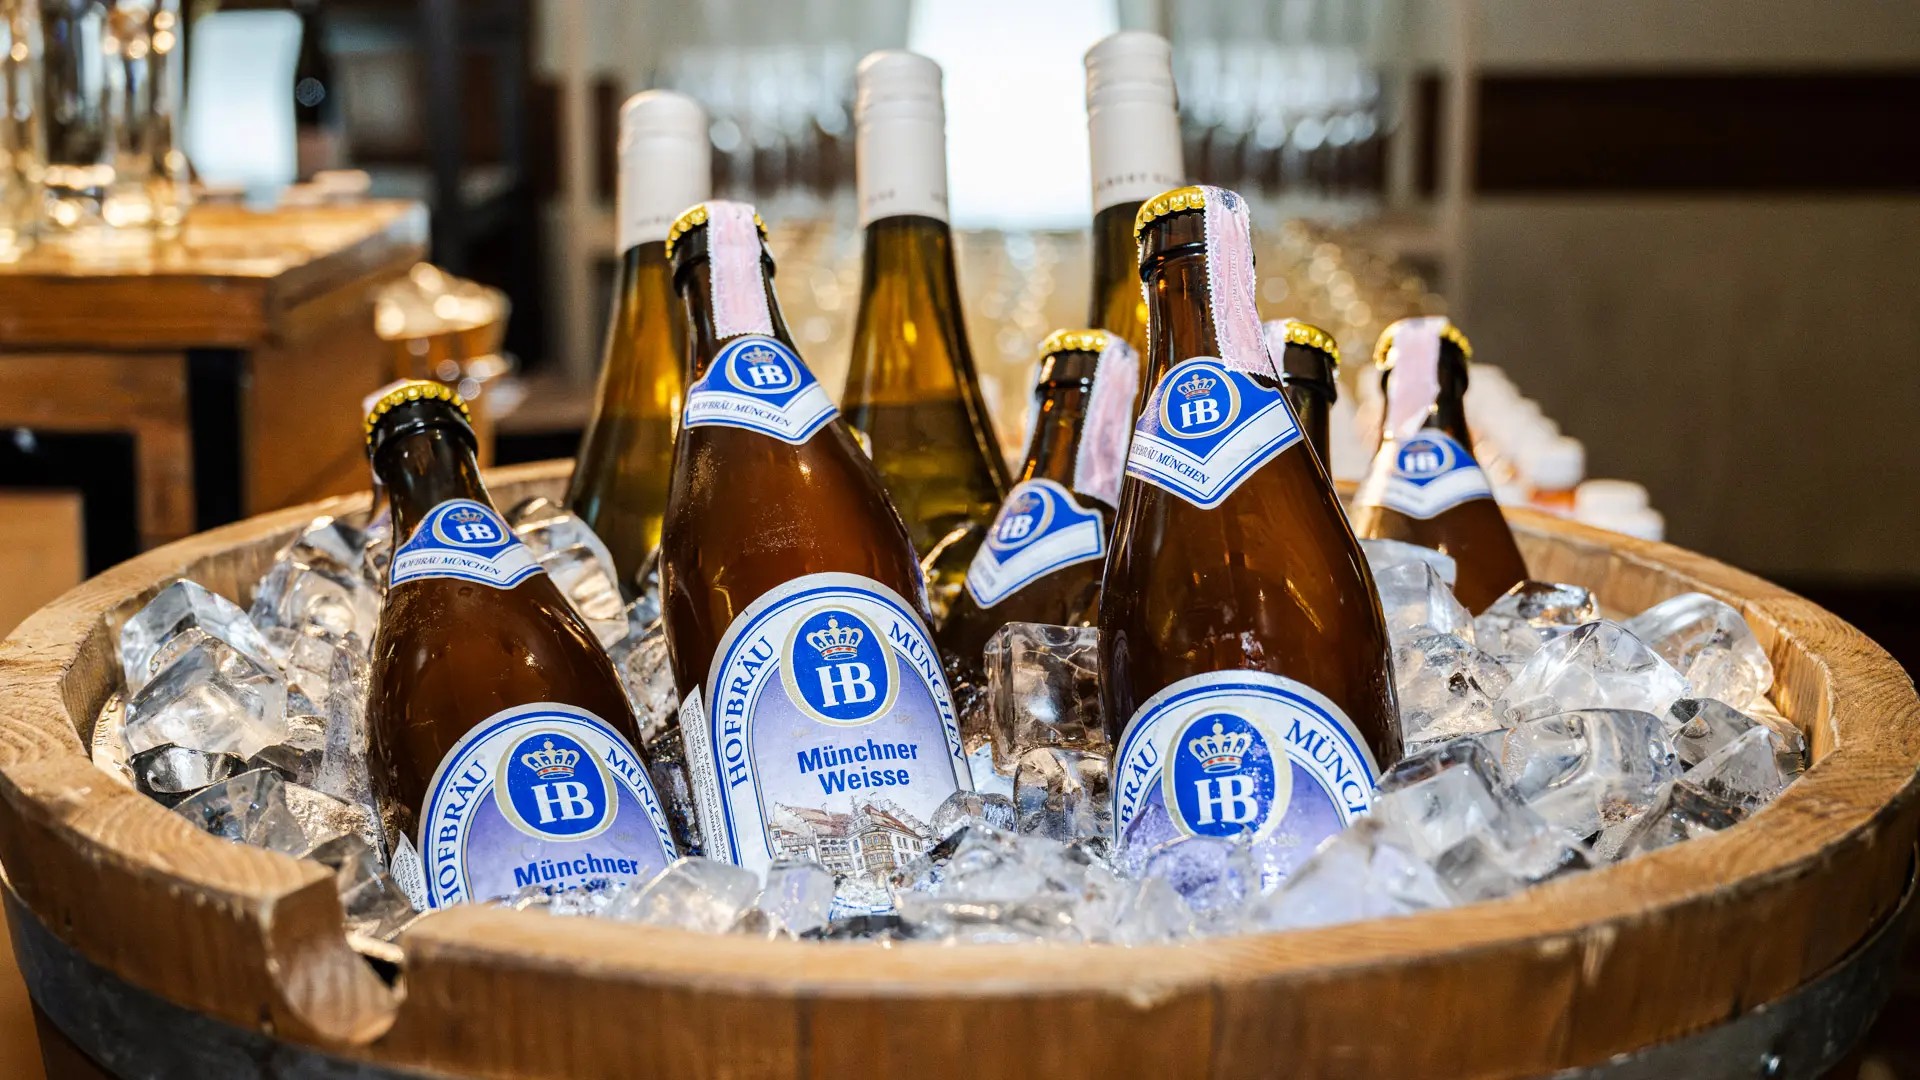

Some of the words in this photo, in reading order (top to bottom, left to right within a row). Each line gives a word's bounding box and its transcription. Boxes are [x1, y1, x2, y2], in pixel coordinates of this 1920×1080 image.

[748, 364, 787, 386] HB
[692, 398, 733, 412] HOFBRÄU
[732, 404, 791, 427] MÜNCHEN
[1180, 398, 1220, 429] HB
[1156, 452, 1210, 485] MÜNCHEN
[456, 523, 495, 542] HB
[398, 556, 440, 570] HOFBRÄU
[441, 557, 501, 575] MÜNCHEN
[815, 662, 876, 708] HB
[724, 636, 773, 789] HOFBRÄU
[888, 621, 964, 761] MÜNCHEN
[797, 739, 917, 773] Münchner
[1121, 738, 1158, 823] BRÄU
[1285, 717, 1367, 814] MÜNC
[818, 768, 910, 795] Weisse
[531, 781, 595, 825] HB
[1194, 774, 1258, 825] HB
[514, 853, 637, 887] Münchner
